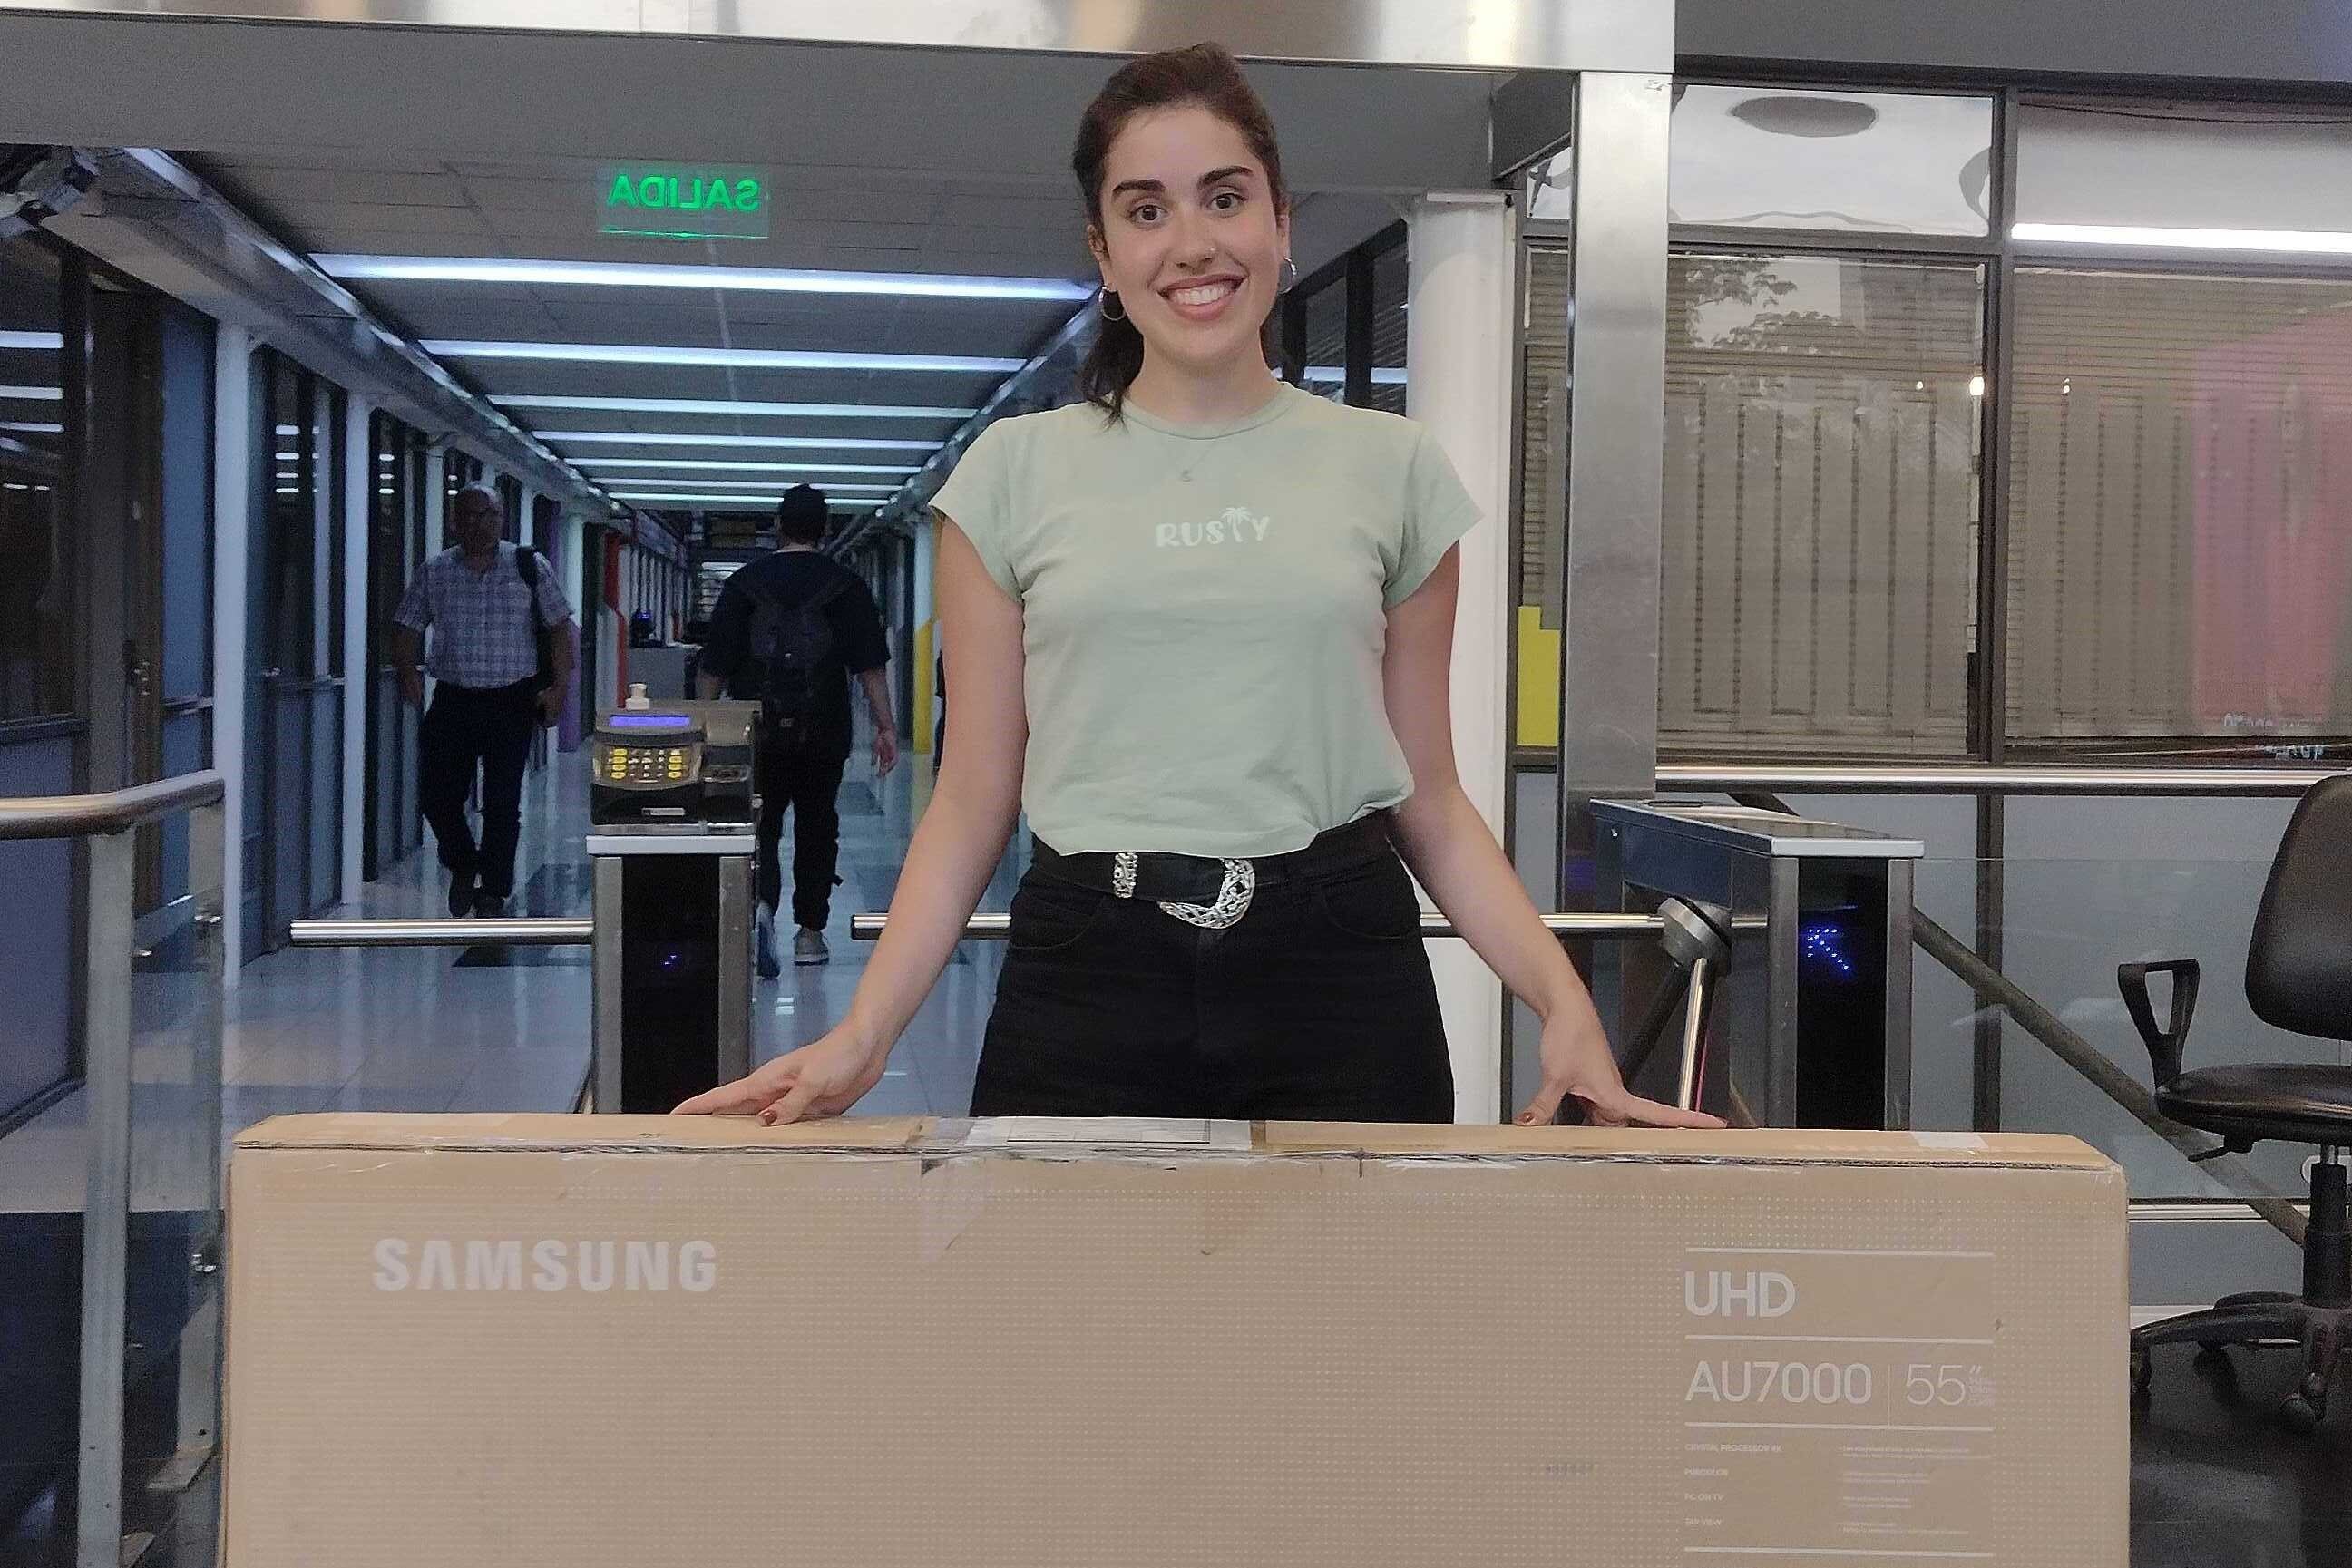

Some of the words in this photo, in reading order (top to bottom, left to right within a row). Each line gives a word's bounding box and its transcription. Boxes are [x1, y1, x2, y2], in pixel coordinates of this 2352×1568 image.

[1155, 507, 1270, 546] RUSTY
[373, 1238, 717, 1291] SAMSUNG
[1684, 1271, 1796, 1317] UHD
[1685, 1360, 1872, 1404] AU7000
